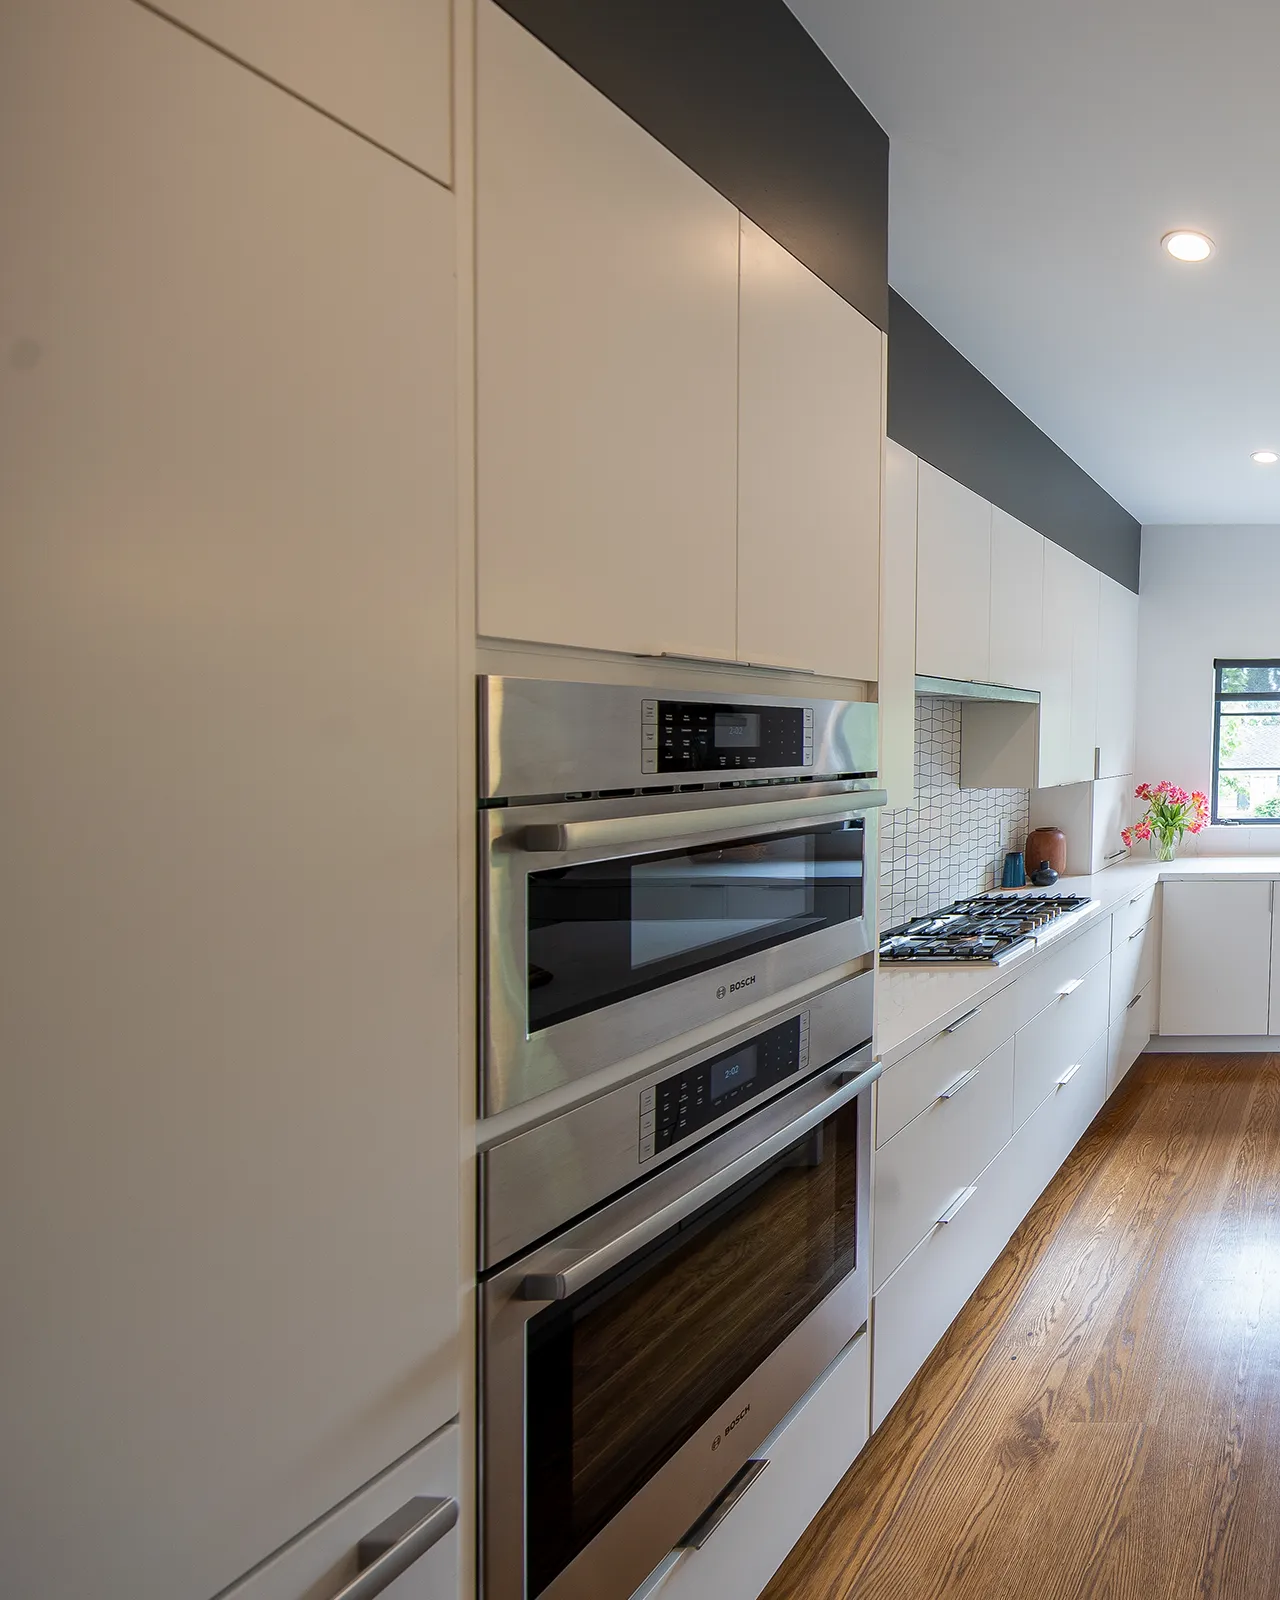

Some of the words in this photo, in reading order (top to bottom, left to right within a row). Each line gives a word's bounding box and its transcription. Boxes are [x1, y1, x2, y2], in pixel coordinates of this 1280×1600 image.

[729, 975, 756, 993] BOSCH
[724, 1065, 740, 1079] 2:02
[724, 1403, 750, 1437] BOSCH
